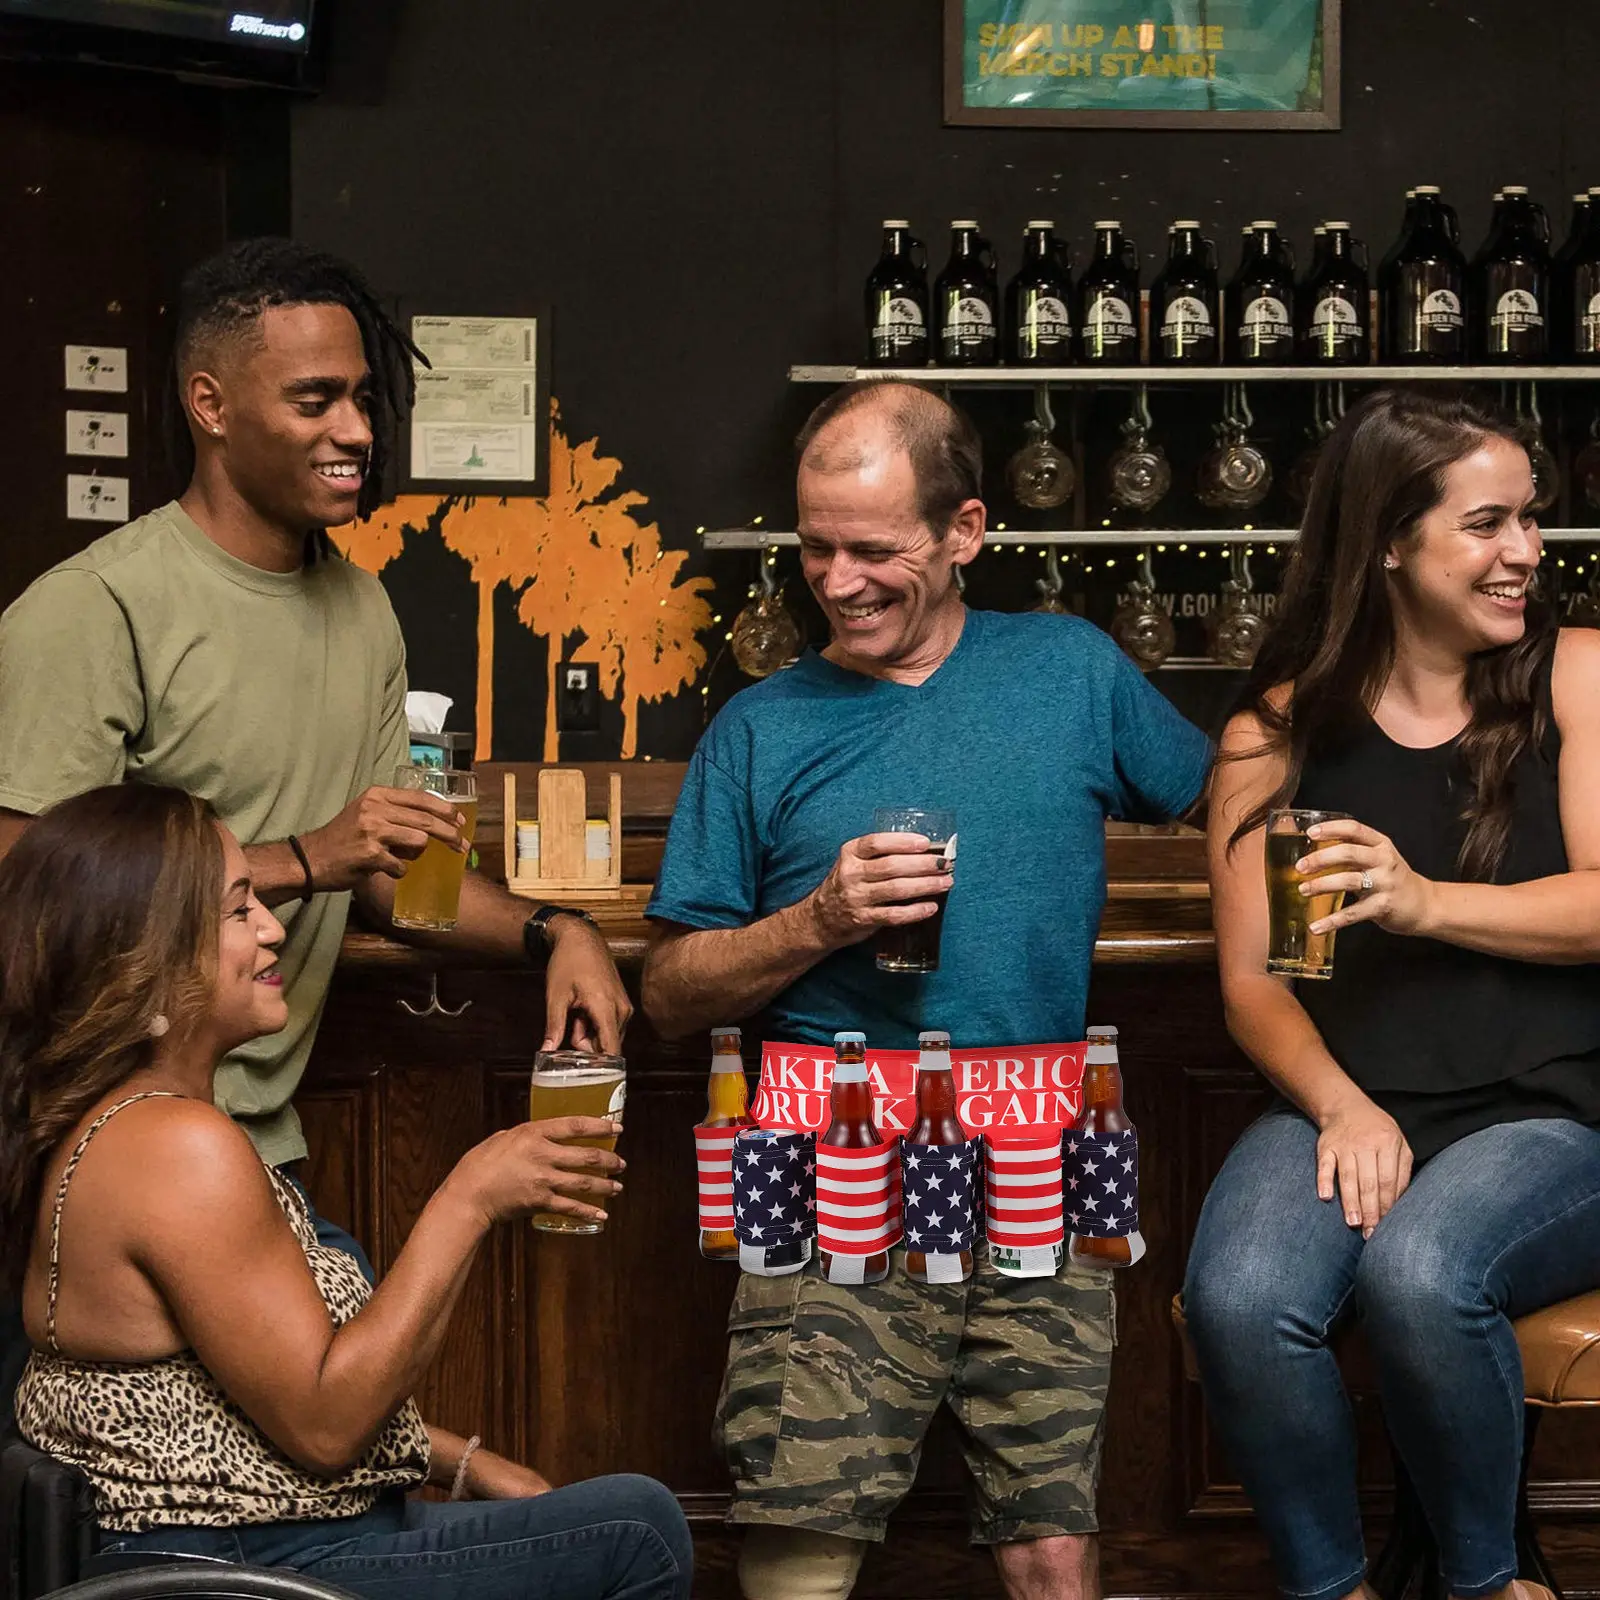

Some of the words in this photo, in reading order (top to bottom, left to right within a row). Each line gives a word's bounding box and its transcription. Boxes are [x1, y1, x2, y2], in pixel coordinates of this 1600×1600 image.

[1061, 24, 1104, 49] UP
[1111, 25, 1155, 50] AT
[1160, 25, 1225, 49] THE
[1100, 53, 1217, 80] STAND!
[760, 1054, 837, 1093] AKE
